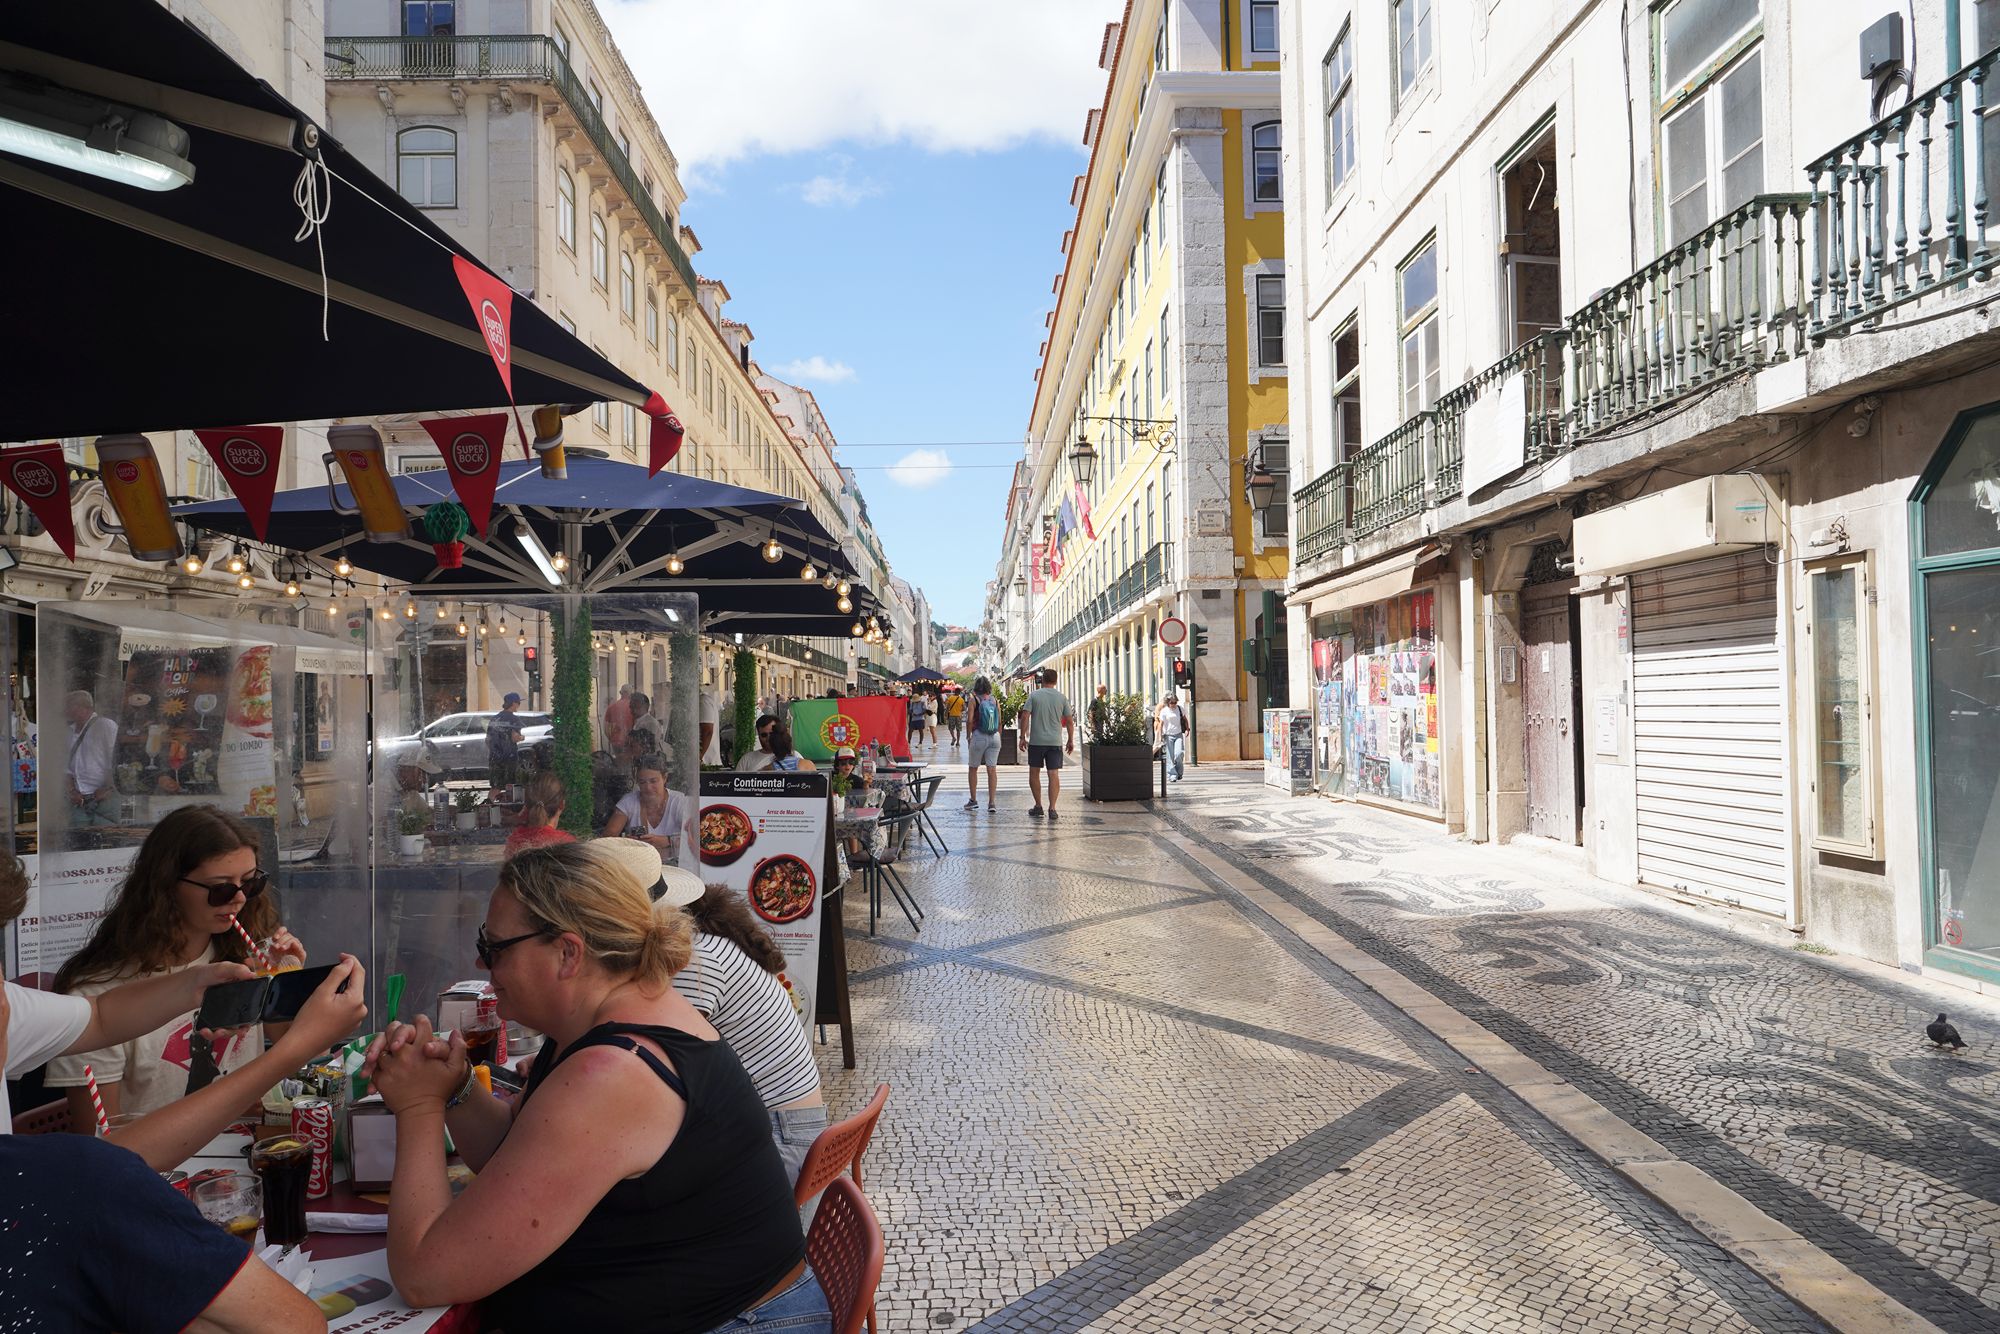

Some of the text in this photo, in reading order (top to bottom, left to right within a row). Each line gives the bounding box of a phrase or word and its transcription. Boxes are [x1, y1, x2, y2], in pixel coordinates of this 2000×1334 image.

[485, 315, 504, 335] SUPER
[228, 447, 261, 457] SUPER
[456, 444, 484, 455] SUPER
[231, 456, 261, 465] BOCK
[459, 453, 484, 463] BOCK
[17, 469, 49, 480] SUPER
[22, 476, 53, 488] BOCK
[86, 581, 104, 597] 57
[733, 777, 785, 788] Continental
